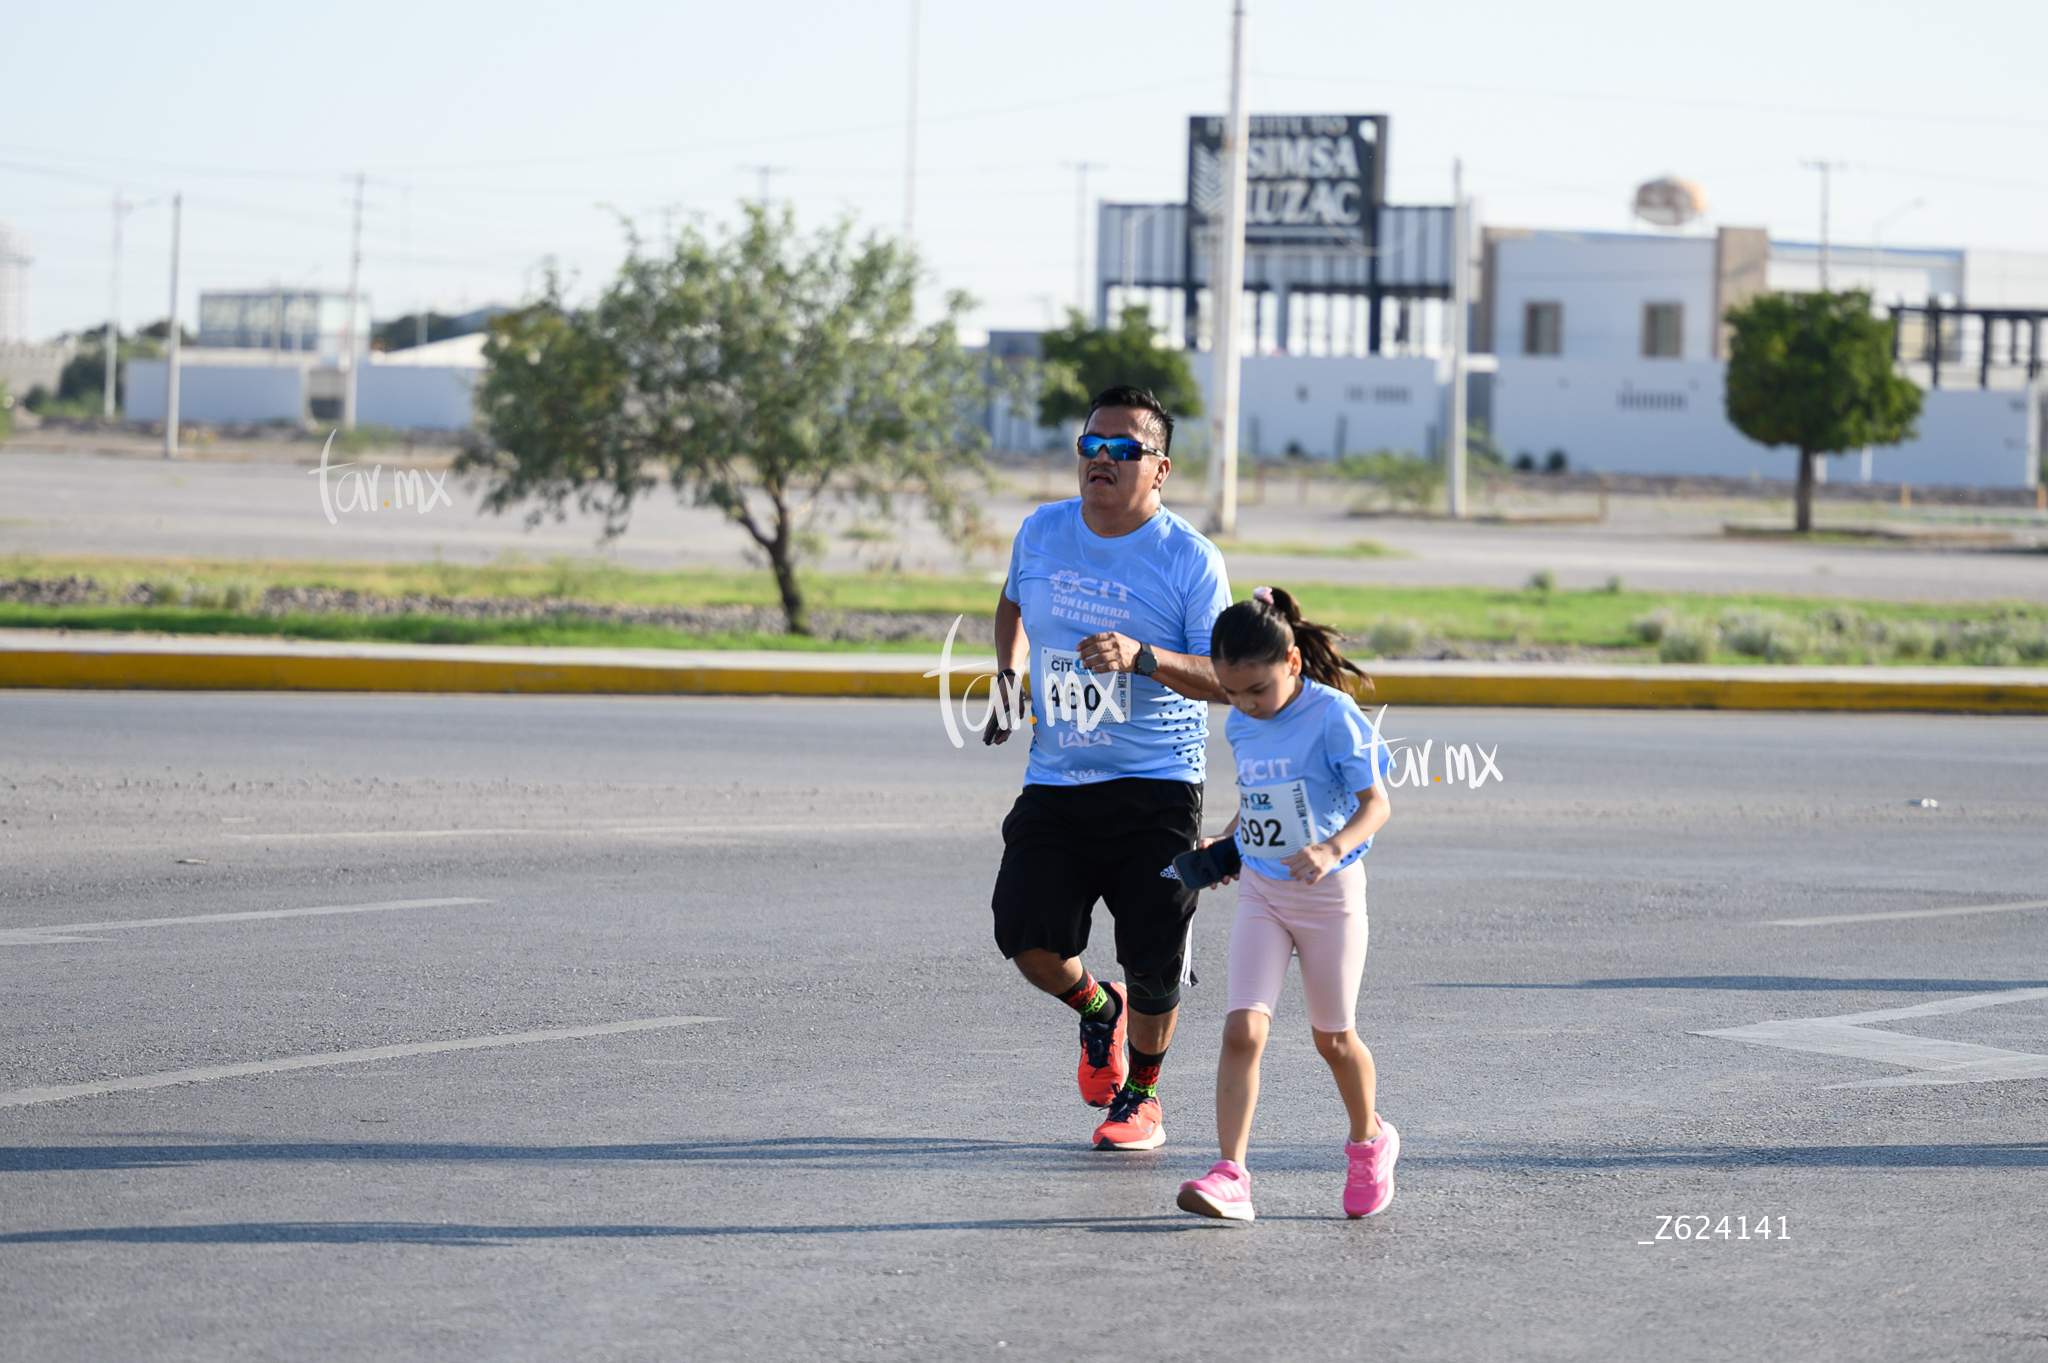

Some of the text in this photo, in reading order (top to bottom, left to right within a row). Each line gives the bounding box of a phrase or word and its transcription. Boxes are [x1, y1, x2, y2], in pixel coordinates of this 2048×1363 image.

[1078, 577, 1133, 602] CIT
[1051, 605, 1066, 617] DE
[1067, 609, 1080, 621] LA
[1076, 599, 1090, 611] LA
[1091, 603, 1130, 620] FUERZA
[1051, 660, 1073, 673] CIT
[1047, 680, 1101, 711] 460
[1058, 731, 1112, 749] LALA
[1250, 758, 1292, 780] CIT
